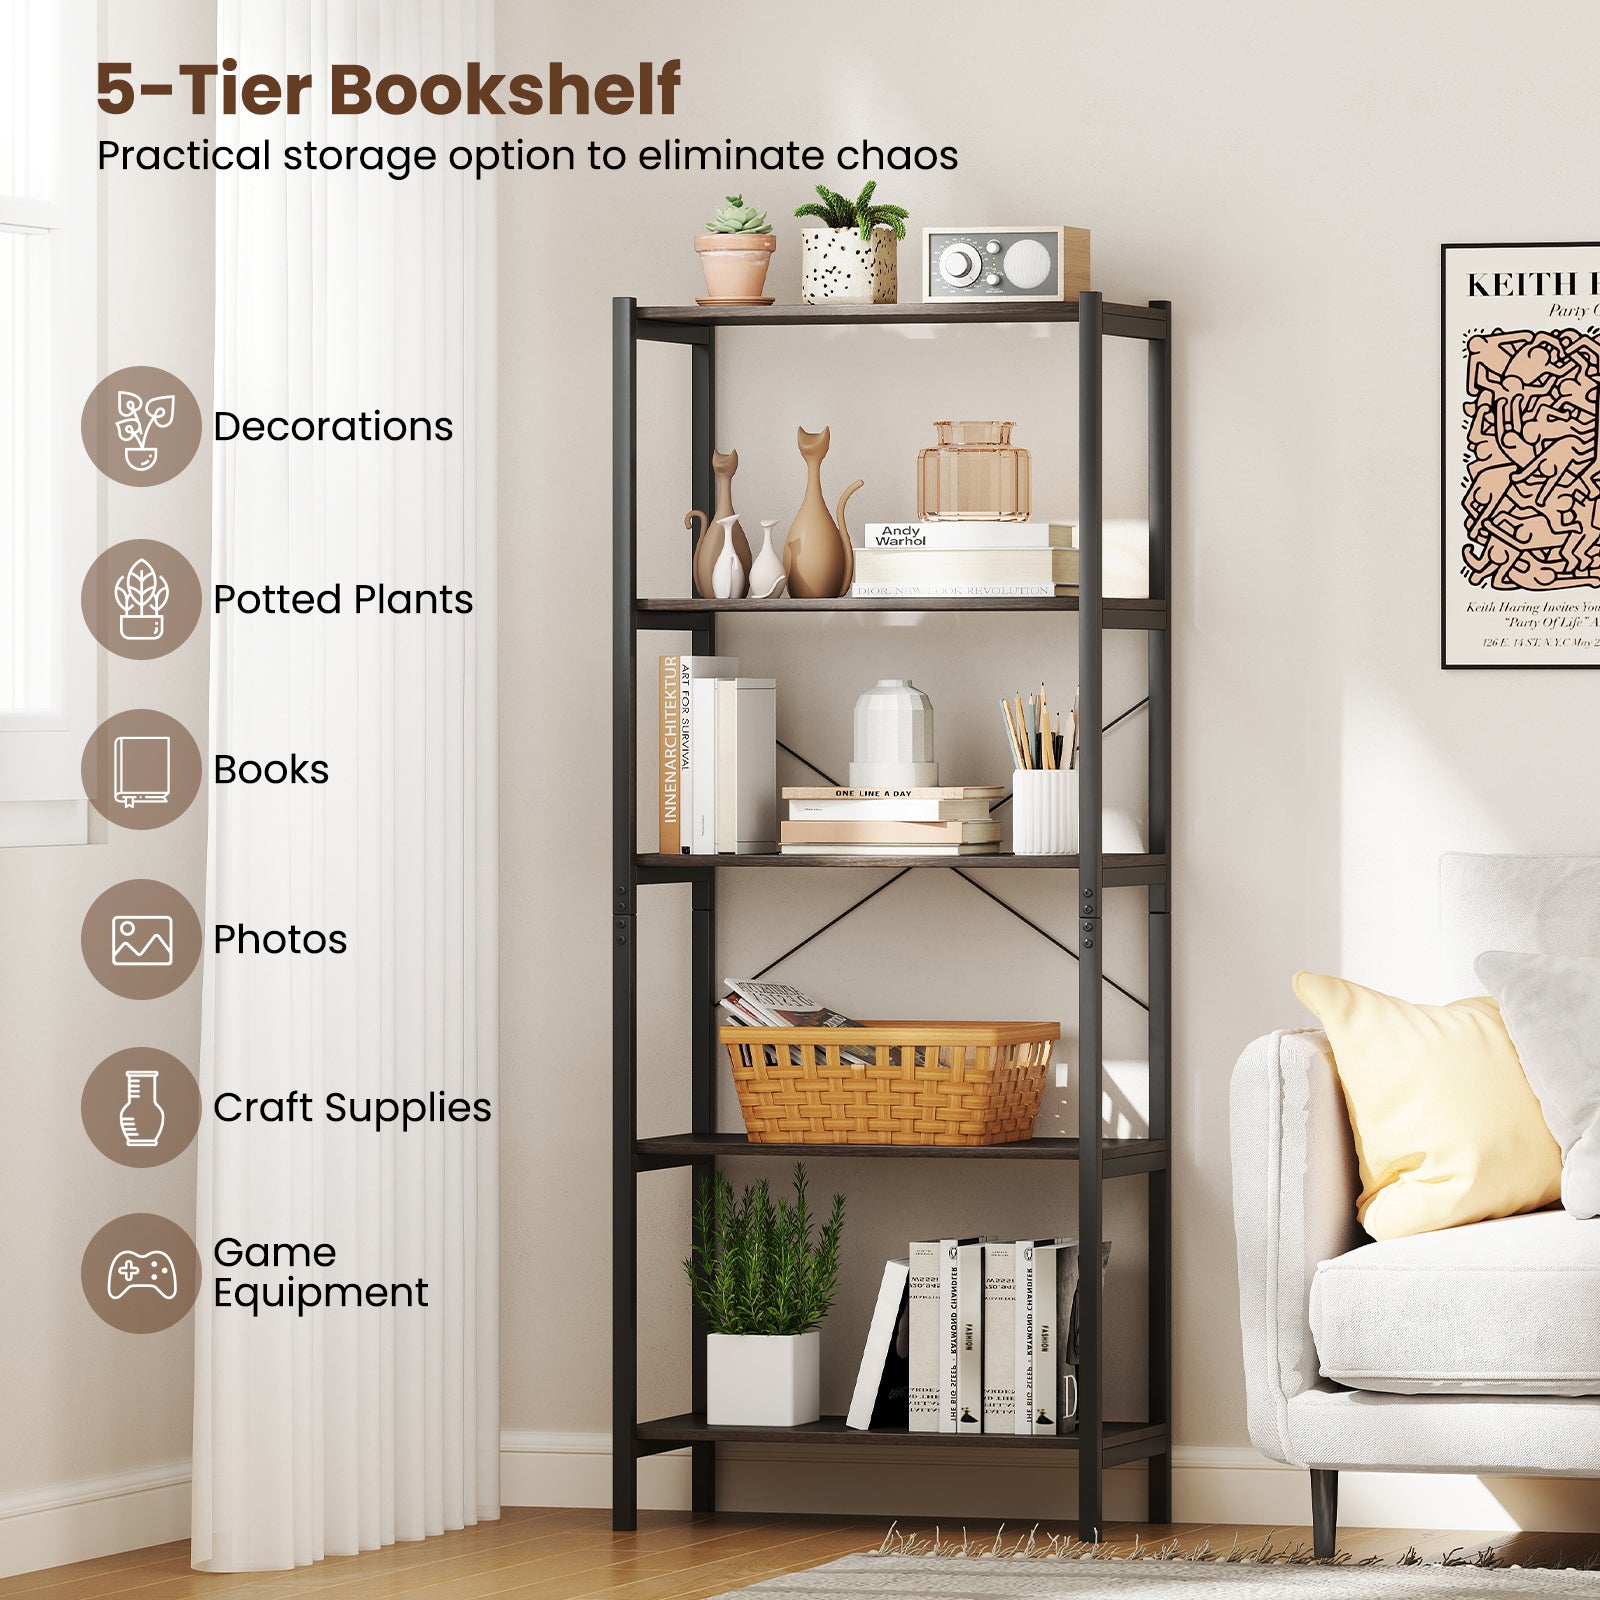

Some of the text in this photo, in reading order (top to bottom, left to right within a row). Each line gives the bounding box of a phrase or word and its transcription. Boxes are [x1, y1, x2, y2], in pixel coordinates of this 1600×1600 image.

[1466, 271, 1578, 297] KEITH
[1549, 303, 1589, 320] Party
[882, 526, 921, 538] Andy
[876, 536, 926, 546] Warhol
[896, 586, 922, 595] NEW
[926, 586, 963, 595] LOOK
[967, 586, 1049, 595] REVOLUTION
[1466, 601, 1495, 613] Keith
[1499, 601, 1540, 615] Haring
[1543, 601, 1579, 612] Invites
[1543, 616, 1560, 630] Of
[1483, 637, 1498, 648] 126
[681, 664, 690, 771] ART FOR SURVIVAL
[664, 656, 677, 823] INNENARCHITEKTUR
[965, 1324, 973, 1351] FASHION
[1041, 1325, 1049, 1353] FASHION
